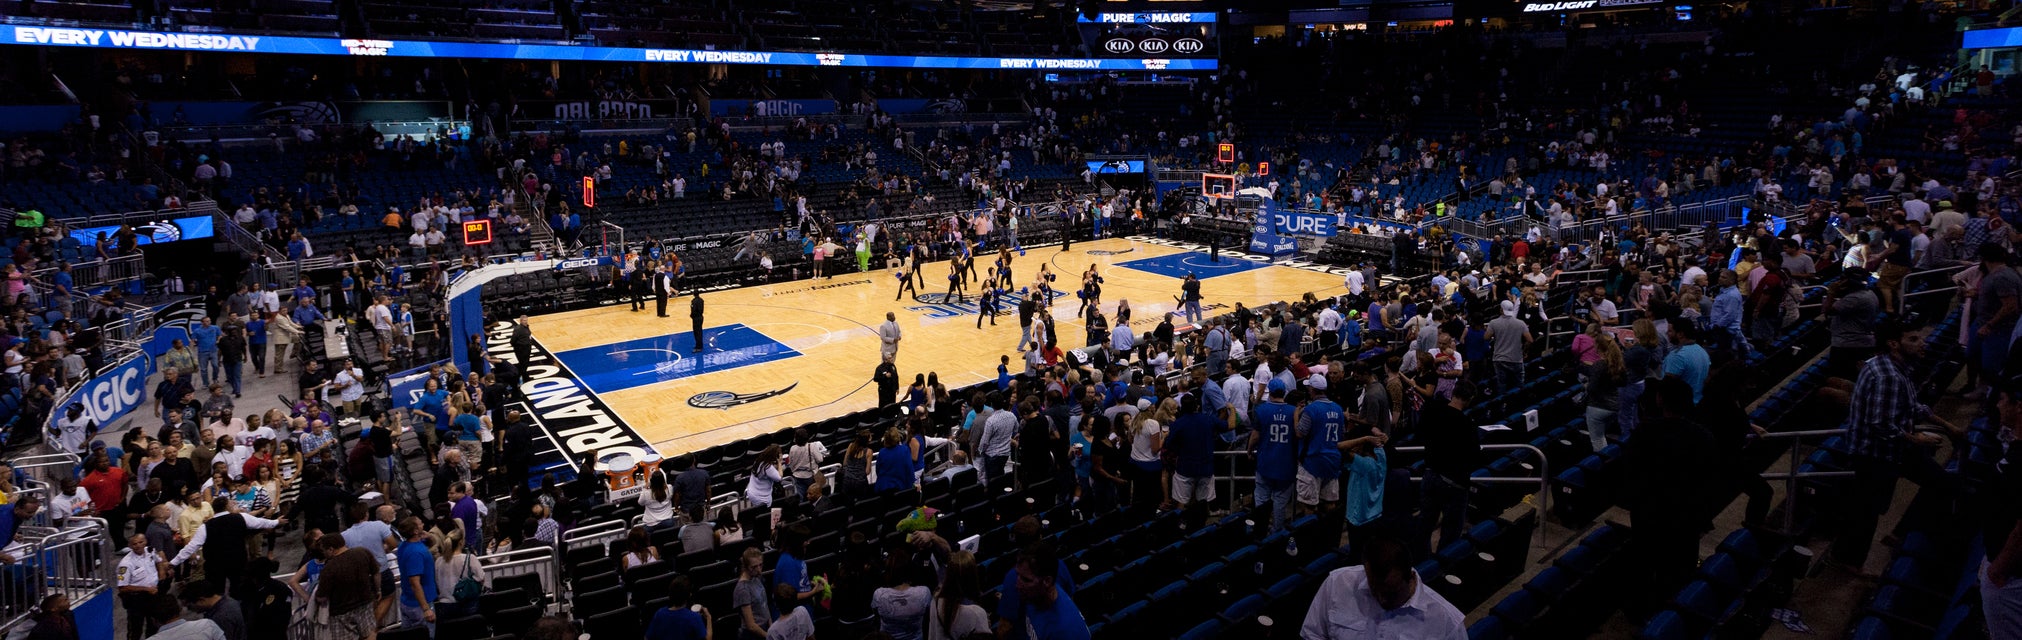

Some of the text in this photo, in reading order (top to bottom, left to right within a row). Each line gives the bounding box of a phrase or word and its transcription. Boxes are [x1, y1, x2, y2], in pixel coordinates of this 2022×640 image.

[1523, 3, 1554, 12] BUD
[1554, 0, 1598, 10] LIGHT
[1103, 13, 1191, 22] PURE MAGIC
[15, 27, 260, 50] EVERY WEDNESDAY
[645, 50, 772, 63] EVERY WEDNESDAY
[1000, 59, 1101, 69] EVERY WEDNESDAY
[766, 100, 803, 117] AGIC
[1275, 214, 1327, 234] PURE
[666, 244, 686, 252] PURE
[695, 241, 721, 249] MAGIC
[562, 259, 598, 269] GEICO
[78, 367, 141, 427] AGIC
[520, 365, 648, 472] ORLANDO
[1269, 424, 1289, 443] 92
[1325, 422, 1339, 442] 73
[620, 487, 643, 496] GATOR
